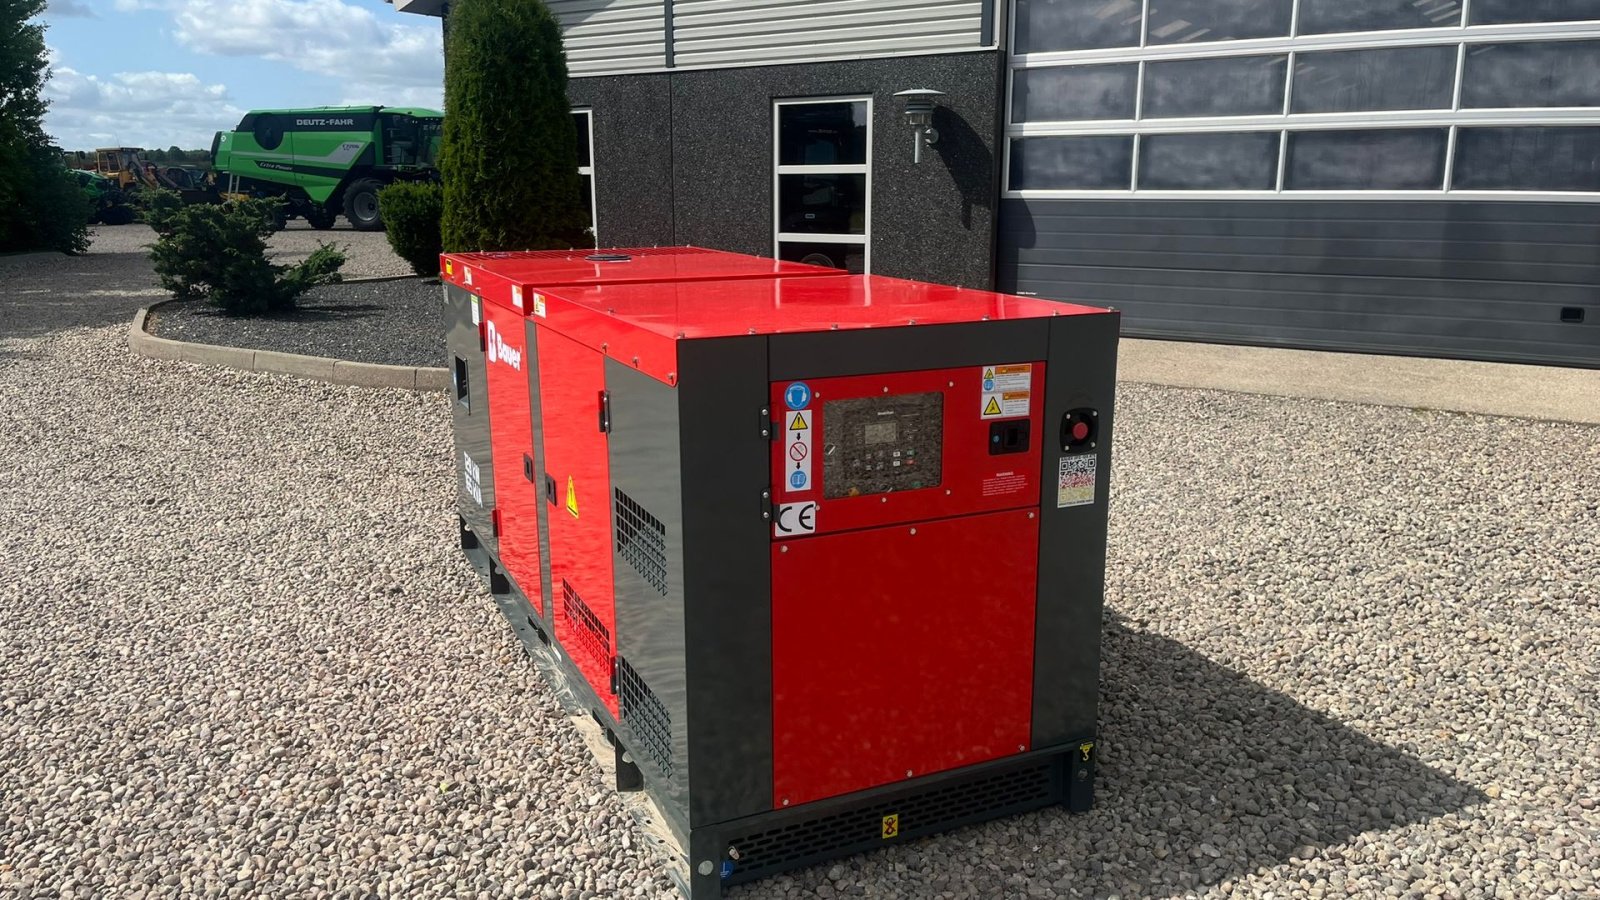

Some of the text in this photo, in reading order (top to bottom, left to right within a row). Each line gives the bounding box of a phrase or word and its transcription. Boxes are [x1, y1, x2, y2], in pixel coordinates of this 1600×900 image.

[296, 118, 354, 126] DEUTZ-FAHR
[496, 331, 521, 372] Bauer
[778, 503, 814, 533] CE
